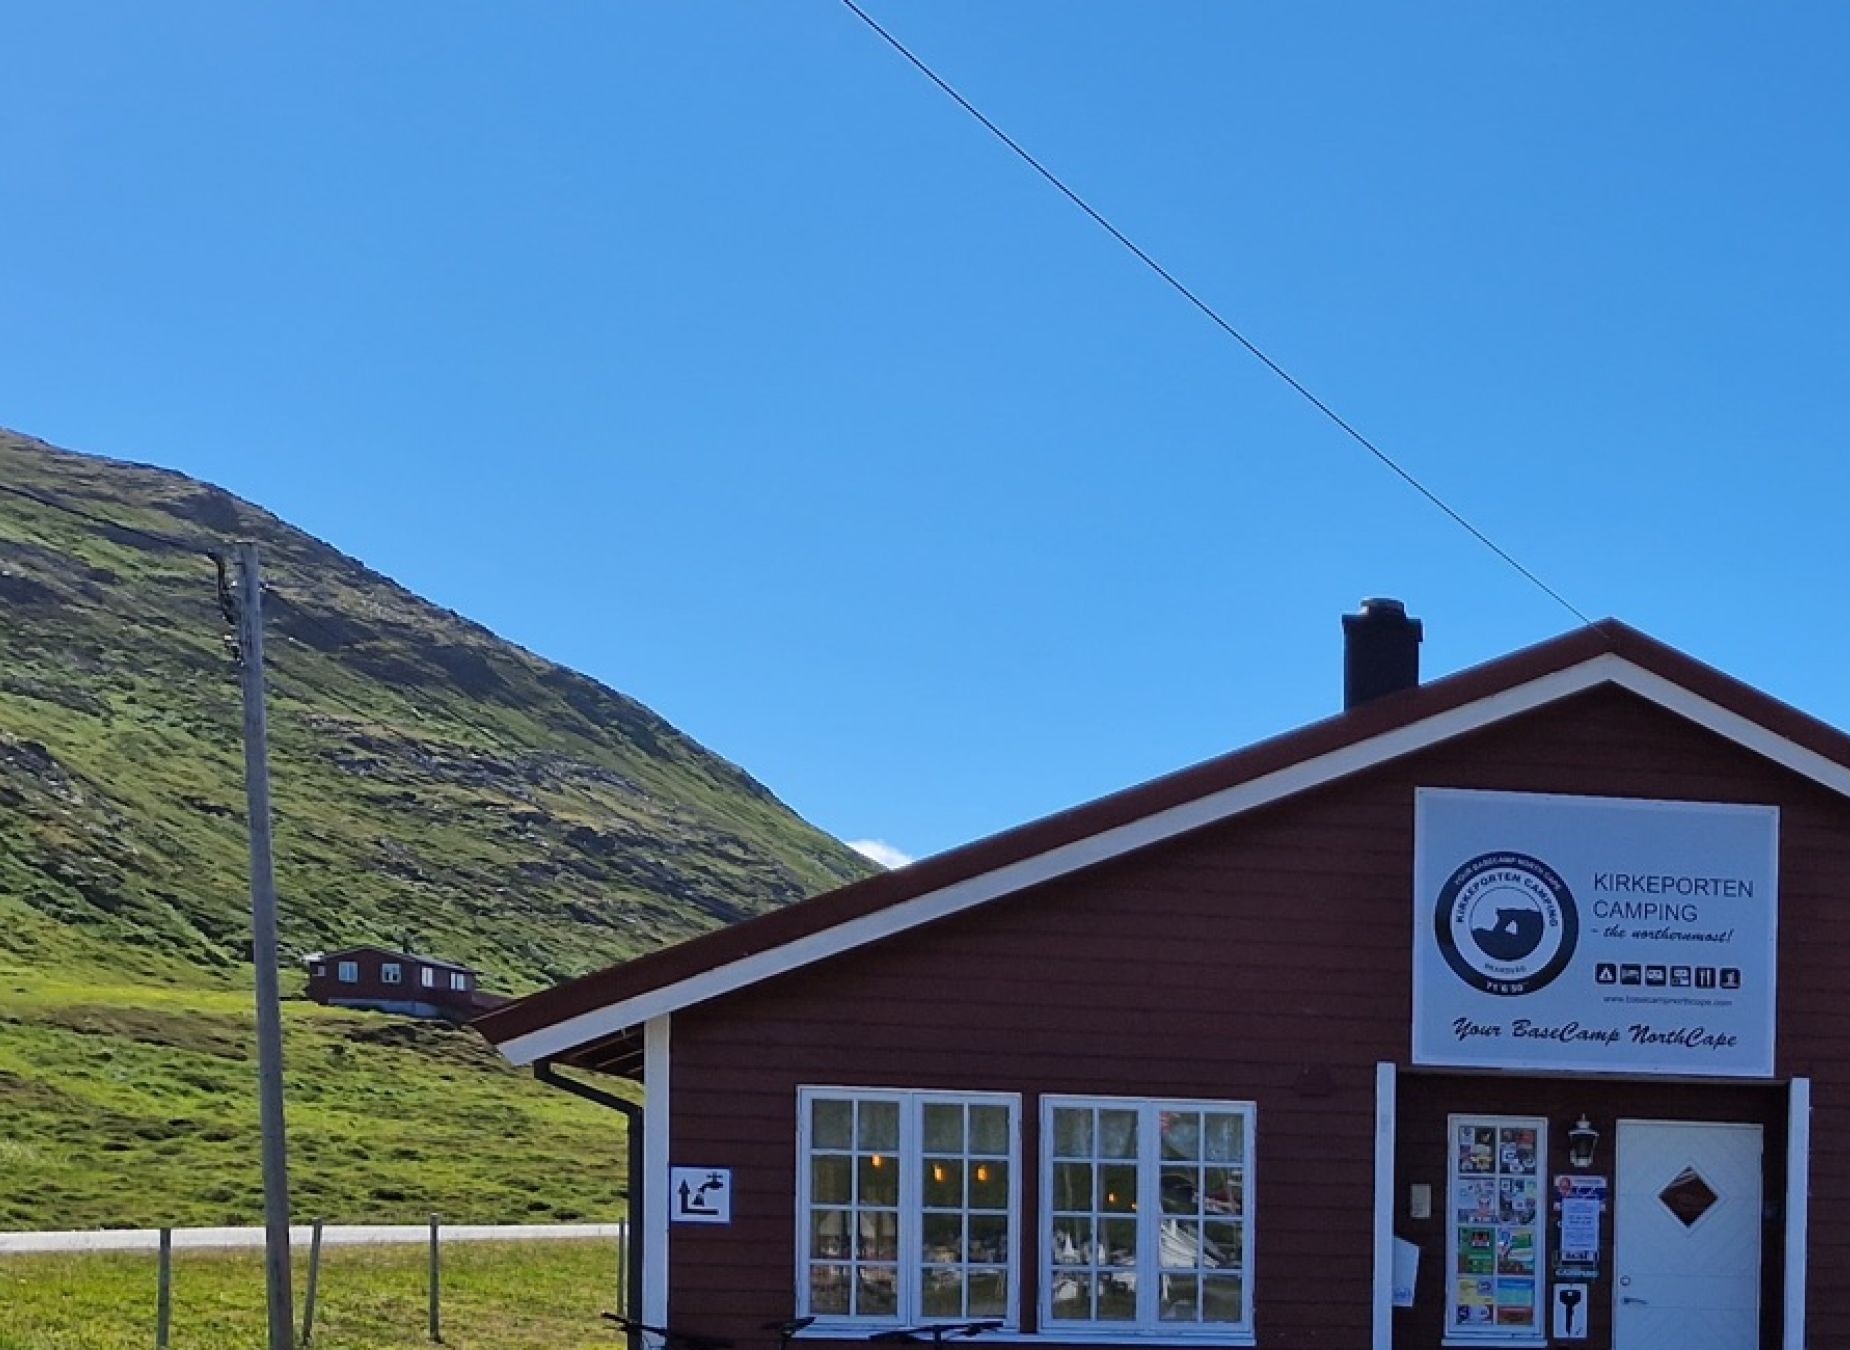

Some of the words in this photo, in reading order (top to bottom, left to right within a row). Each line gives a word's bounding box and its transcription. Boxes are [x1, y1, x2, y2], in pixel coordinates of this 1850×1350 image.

[1593, 872, 1754, 898] KIRKEPORTEN
[1456, 871, 1521, 923] KIRKEPORTEN
[1524, 877, 1559, 928] CAMPING
[1592, 899, 1699, 923] CAMPING
[1603, 923, 1627, 940] the
[1631, 926, 1735, 943] northernmost!
[1452, 1016, 1502, 1041] Your
[1511, 1018, 1621, 1047] BaseCamp
[1628, 1022, 1738, 1050] NorthCape
